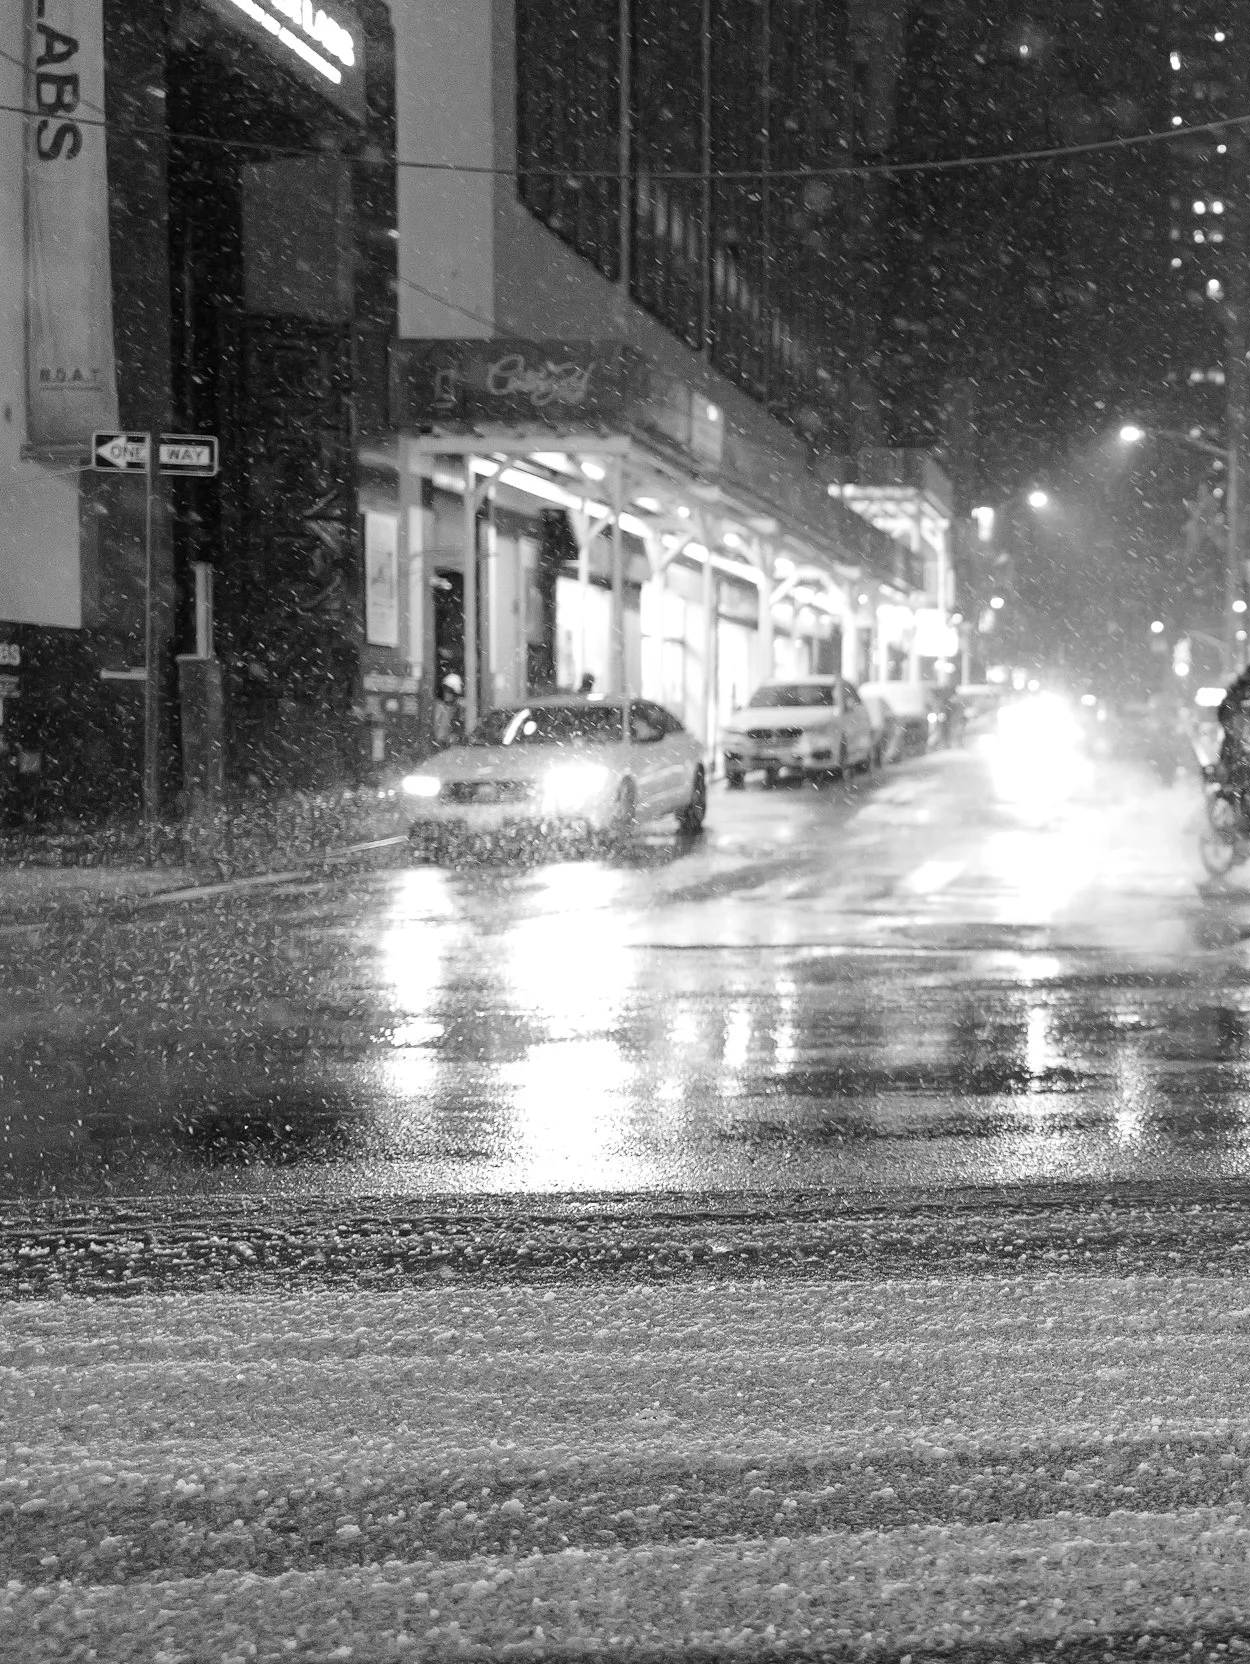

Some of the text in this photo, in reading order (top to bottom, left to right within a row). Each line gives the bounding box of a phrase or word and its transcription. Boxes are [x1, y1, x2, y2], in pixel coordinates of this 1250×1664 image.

[36, 0, 83, 161] ABS
[110, 444, 204, 462] ONE WAY
